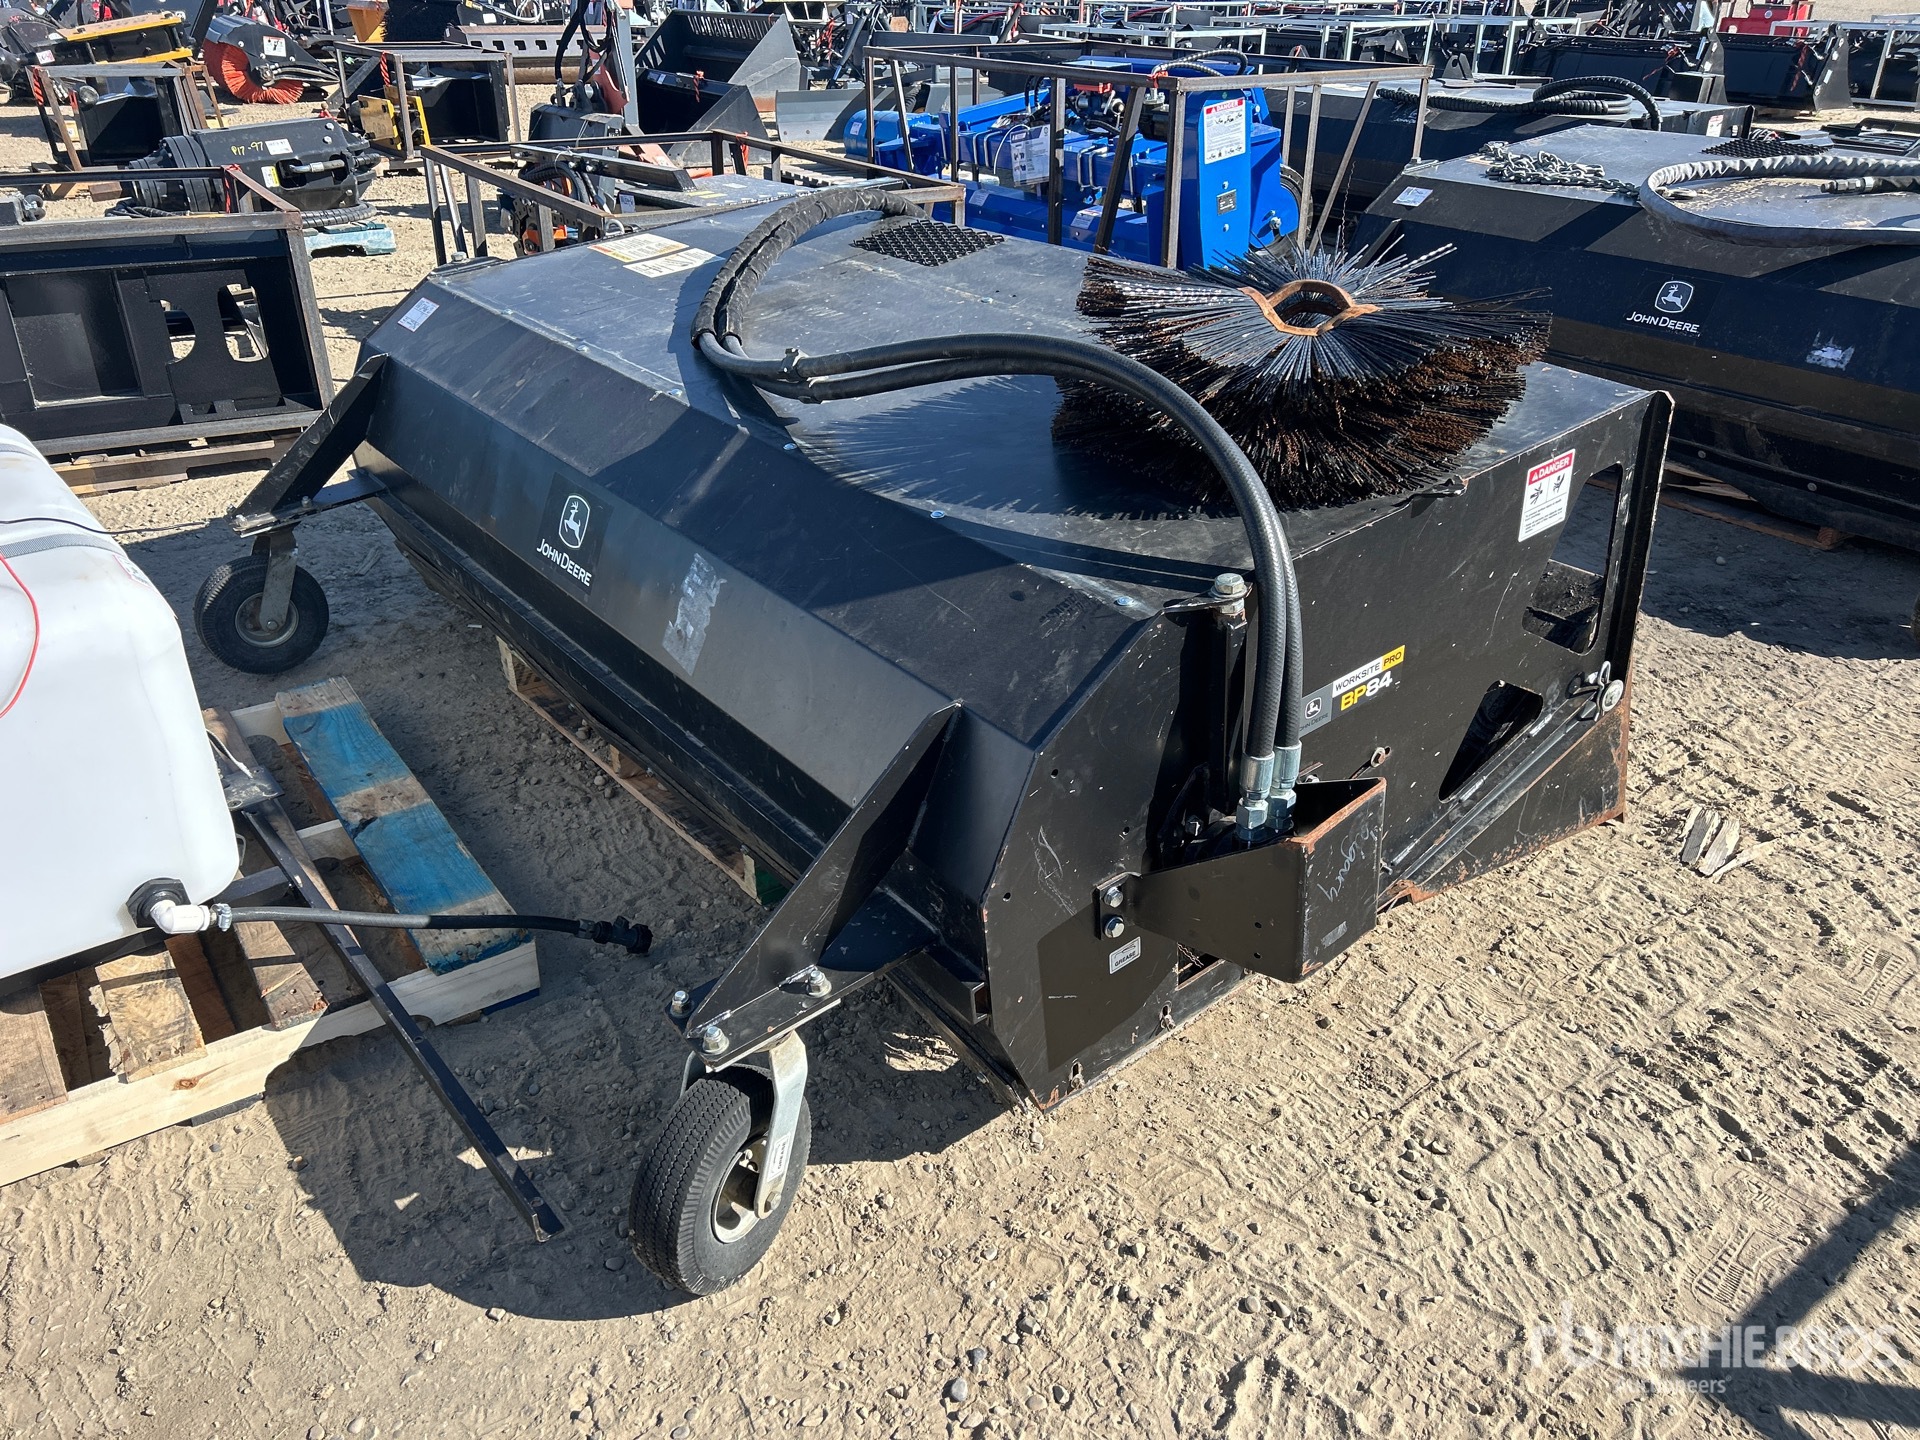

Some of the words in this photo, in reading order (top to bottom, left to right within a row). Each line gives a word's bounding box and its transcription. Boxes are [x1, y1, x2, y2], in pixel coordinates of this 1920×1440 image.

[1626, 311, 1659, 326] JOHN
[1658, 316, 1700, 333] DEERE
[1538, 456, 1570, 478] DANGER
[536, 539, 562, 565] JOHN
[560, 552, 592, 587] DEERE
[1335, 662, 1381, 692] WORKSITE
[1383, 651, 1402, 667] PRO
[1340, 670, 1393, 711] BP84
[1114, 950, 1136, 967] GREASE
